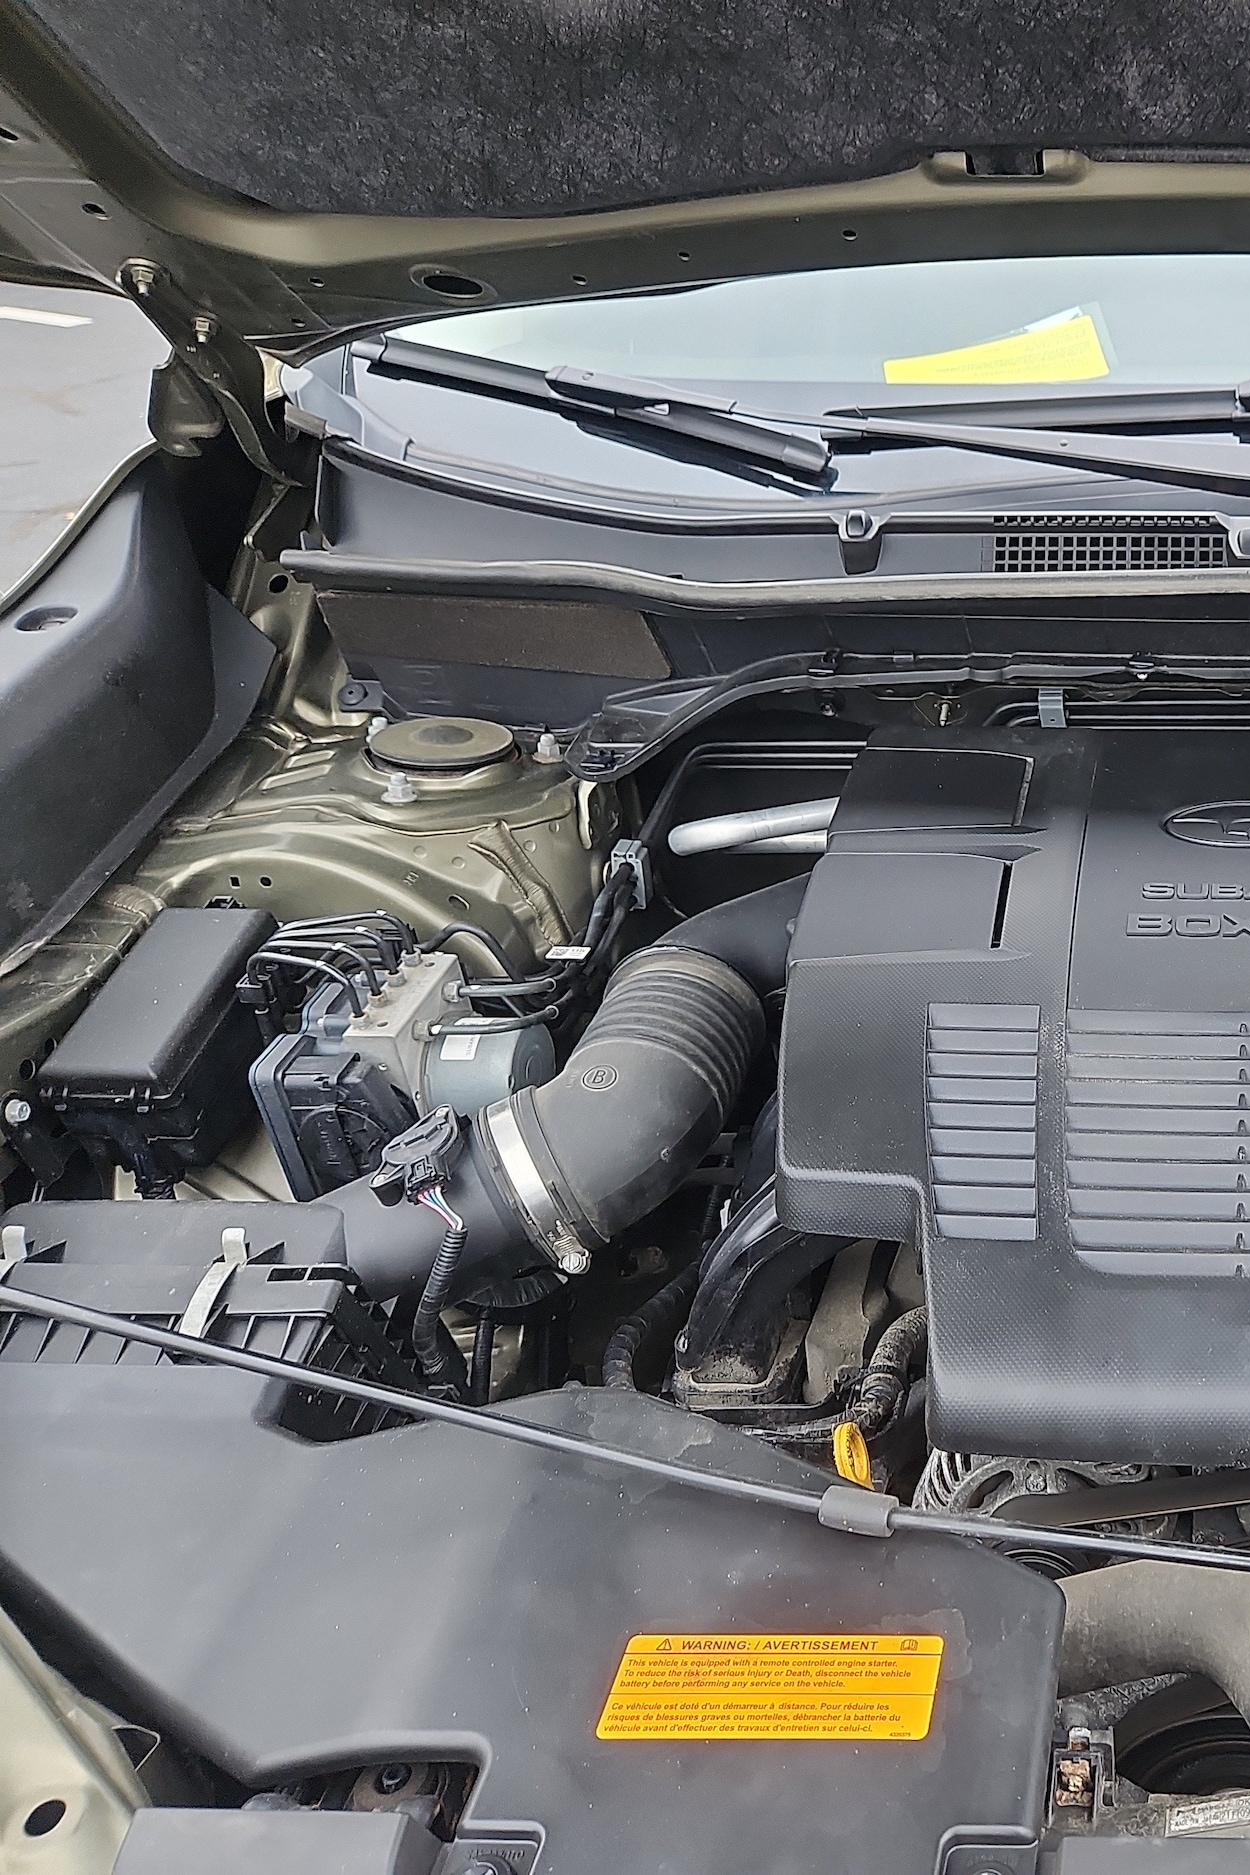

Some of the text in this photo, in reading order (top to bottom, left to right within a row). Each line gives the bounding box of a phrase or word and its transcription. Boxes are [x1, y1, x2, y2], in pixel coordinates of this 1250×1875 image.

[682, 1641, 751, 1650] WARNING:
[763, 1641, 878, 1651] AVERTISSEMENT
[628, 1659, 645, 1667] This
[648, 1659, 678, 1667] vehicle
[690, 1659, 730, 1668] equipped
[732, 1659, 750, 1667] with
[837, 1660, 866, 1668] engine
[636, 1669, 666, 1677] reduce
[684, 1669, 700, 1677] risk
[620, 1680, 650, 1688] battery
[682, 1680, 730, 1689] performing
[732, 1681, 748, 1689] any
[813, 1680, 846, 1688] vehicle.
[626, 1702, 662, 1710] véhicule
[680, 1702, 699, 1710] doté
[701, 1702, 721, 1710] d'un
[723, 1702, 767, 1710] démarreur
[778, 1702, 818, 1710] distance.
[843, 1703, 874, 1711] réduire
[876, 1703, 890, 1711] les
[607, 1713, 640, 1722] risques
[655, 1713, 699, 1721] blessures
[701, 1714, 731, 1722] graves
[792, 1713, 841, 1721] débrancher
[604, 1724, 641, 1732] véhicule
[642, 1724, 668, 1732] avant
[669, 1724, 717, 1732] d'effectuer
[719, 1724, 735, 1732] des
[737, 1724, 770, 1732] travaux
[772, 1724, 819, 1732] d'entretien
[838, 1724, 873, 1732] celui-ci.
